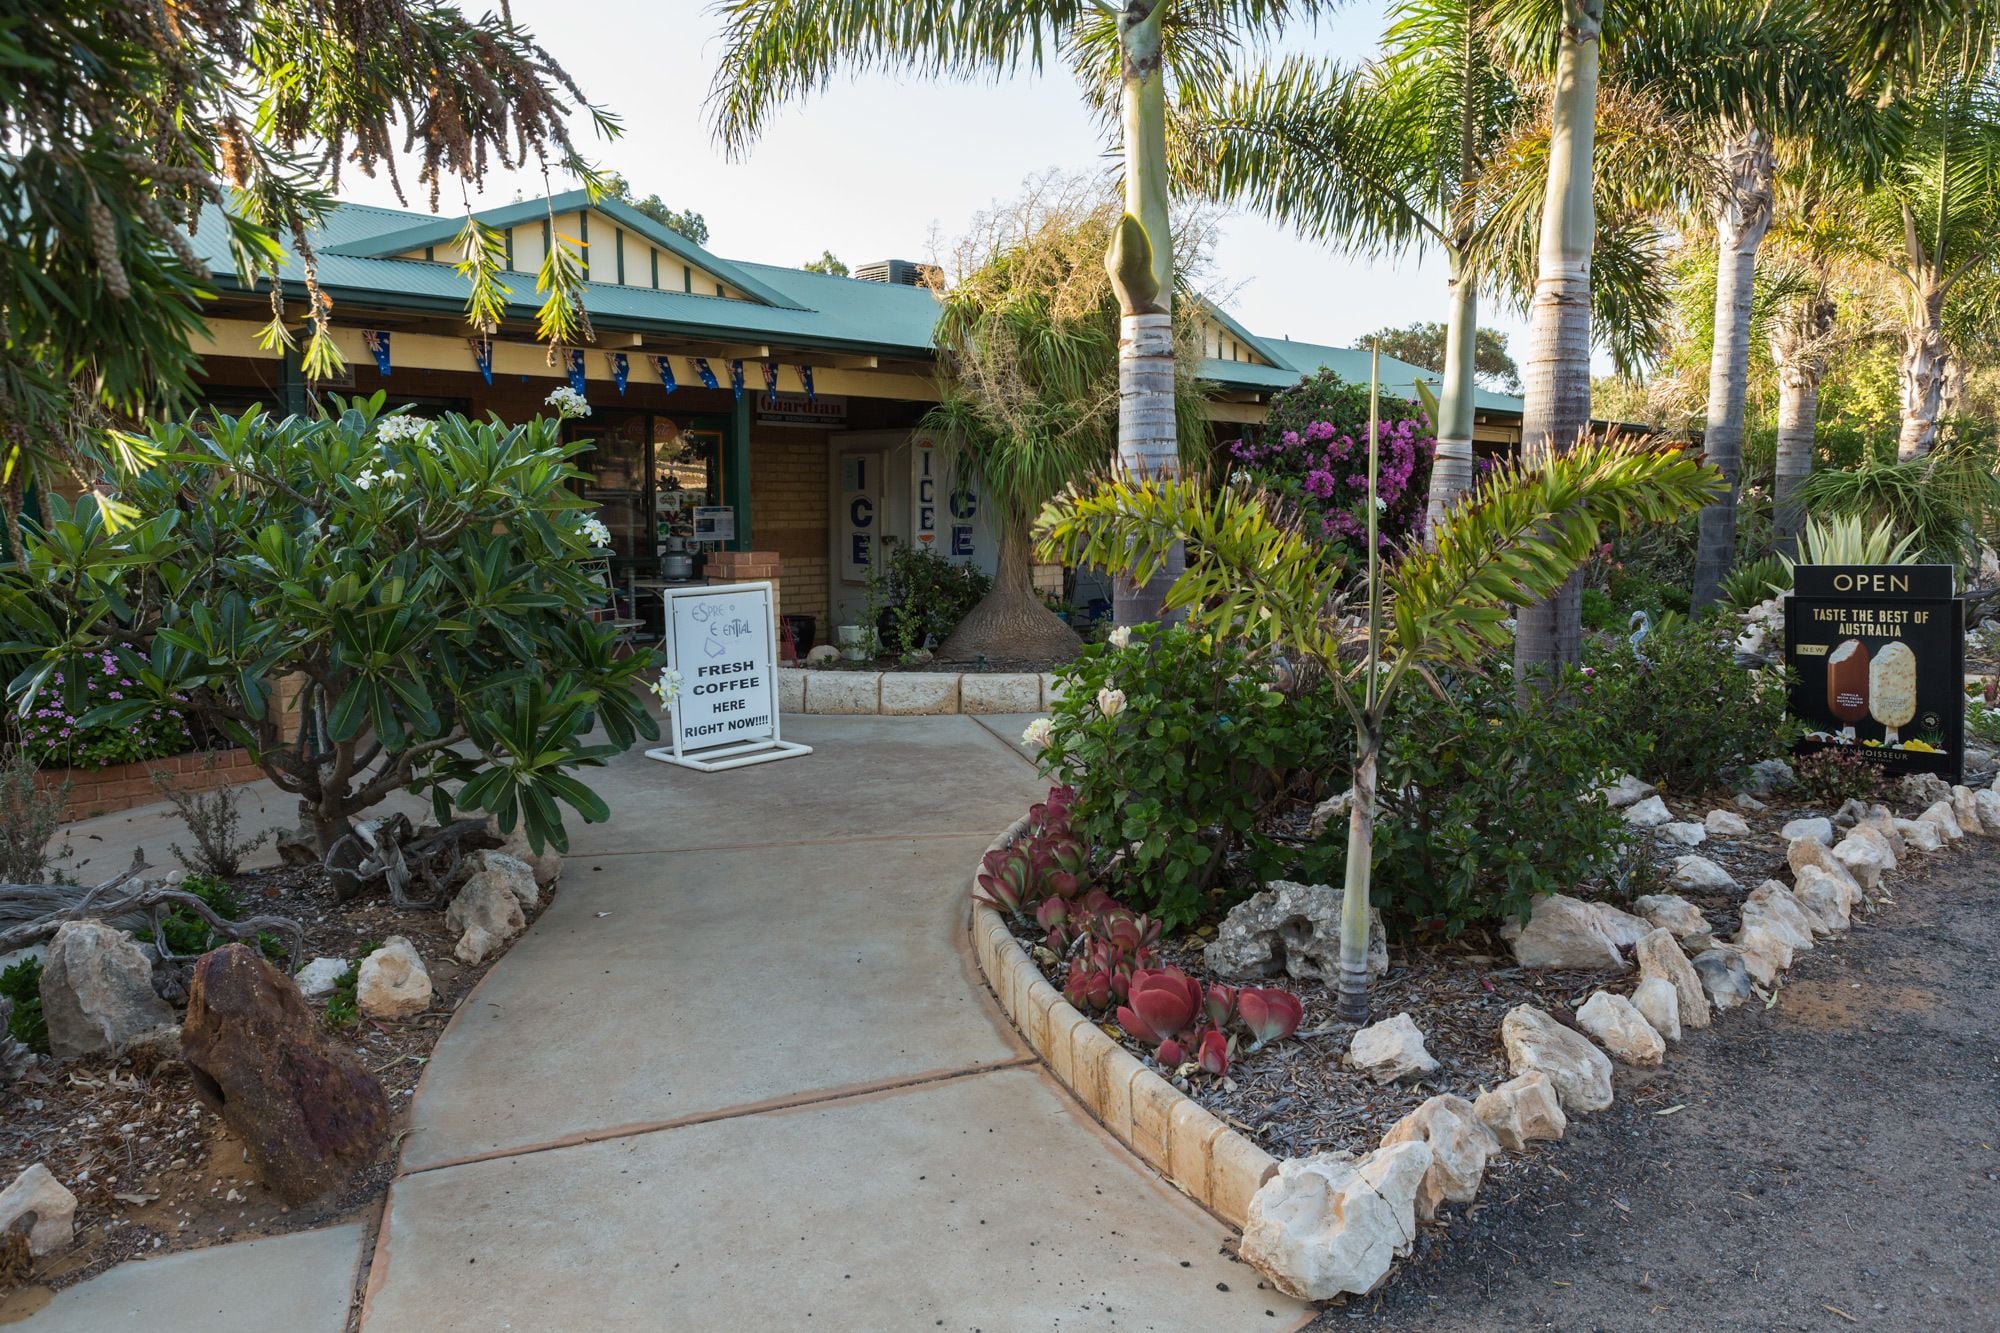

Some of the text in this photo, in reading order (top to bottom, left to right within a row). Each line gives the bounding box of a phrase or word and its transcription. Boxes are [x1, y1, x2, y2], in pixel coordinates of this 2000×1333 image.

[920, 452, 934, 530] ICE
[851, 458, 873, 564] ICE
[1833, 574, 1909, 592] OPEN
[1813, 608, 1929, 624] TASTE THE BEST OF
[1838, 623, 1902, 637] AUSTRALIA
[1802, 646, 1824, 654] NEW
[698, 661, 754, 677] FRESH
[692, 677, 760, 696] COFFEE
[713, 700, 746, 713] HERE
[685, 715, 768, 738] RIGHT NOW!!!!
